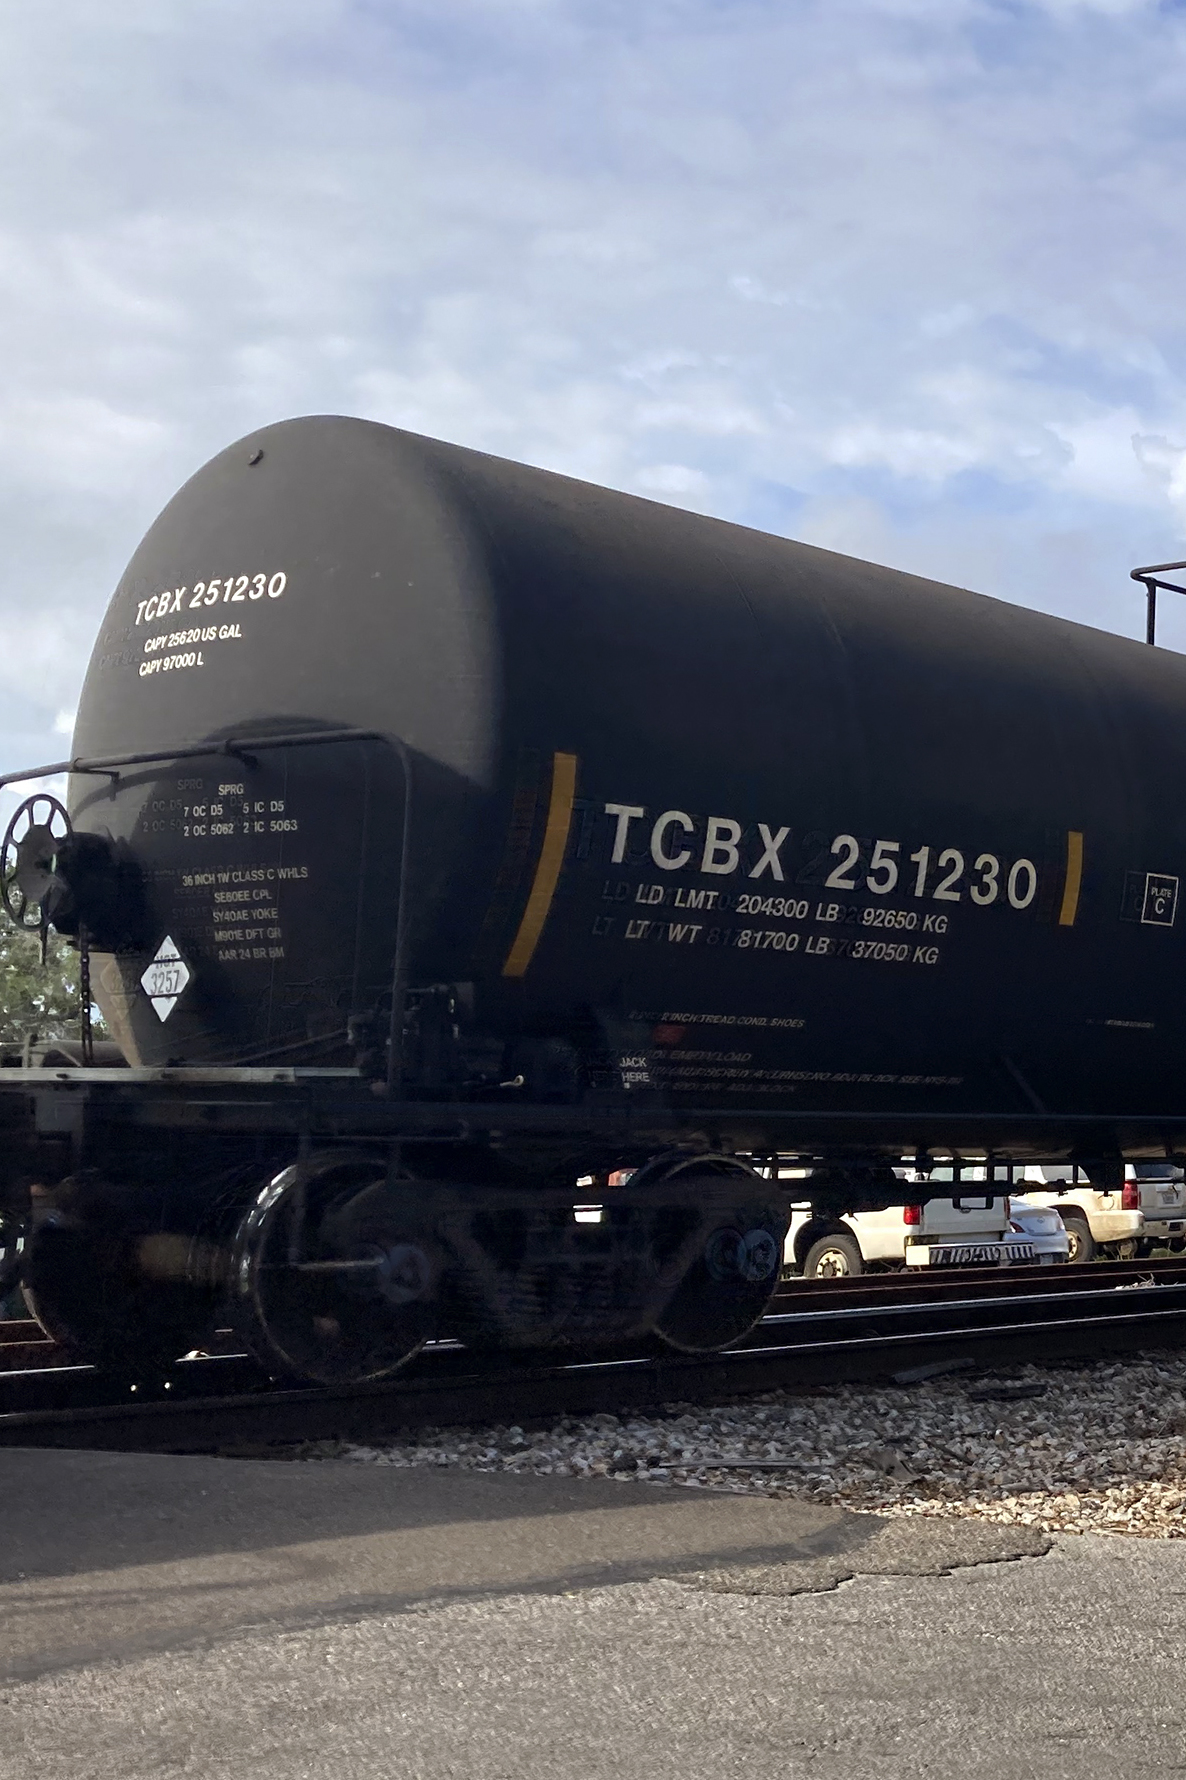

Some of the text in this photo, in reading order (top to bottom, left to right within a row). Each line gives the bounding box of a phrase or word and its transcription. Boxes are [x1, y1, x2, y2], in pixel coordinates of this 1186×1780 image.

[135, 571, 287, 626] TCBX 251230
[143, 623, 242, 653] CAPY 25620 US GAL
[138, 651, 204, 677] CAPY 97000 L
[218, 783, 244, 796] SPRG
[183, 806, 190, 817] 7
[210, 804, 223, 816] D5
[242, 802, 250, 814] 5
[270, 800, 284, 812] D5
[183, 825, 190, 837] 2
[210, 823, 234, 835] 5062
[243, 822, 249, 834] 2
[270, 820, 298, 832] 5063
[604, 803, 1037, 909] TCBX 251230
[182, 874, 193, 887] 36
[194, 873, 215, 885] INCH
[231, 869, 265, 882] CLASS
[266, 868, 275, 880] C
[277, 866, 309, 879] WHLS
[252, 889, 273, 900] CPL
[1151, 887, 1172, 914] PLATE C
[250, 907, 278, 920] YOKE
[635, 883, 948, 934] LD LMT 204300 LB 92650 KG
[625, 919, 940, 965] LT WT 81700 LB 37050 KG
[150, 970, 180, 995] 3257
[619, 1057, 647, 1068] JACK
[621, 1072, 650, 1083] HERE
